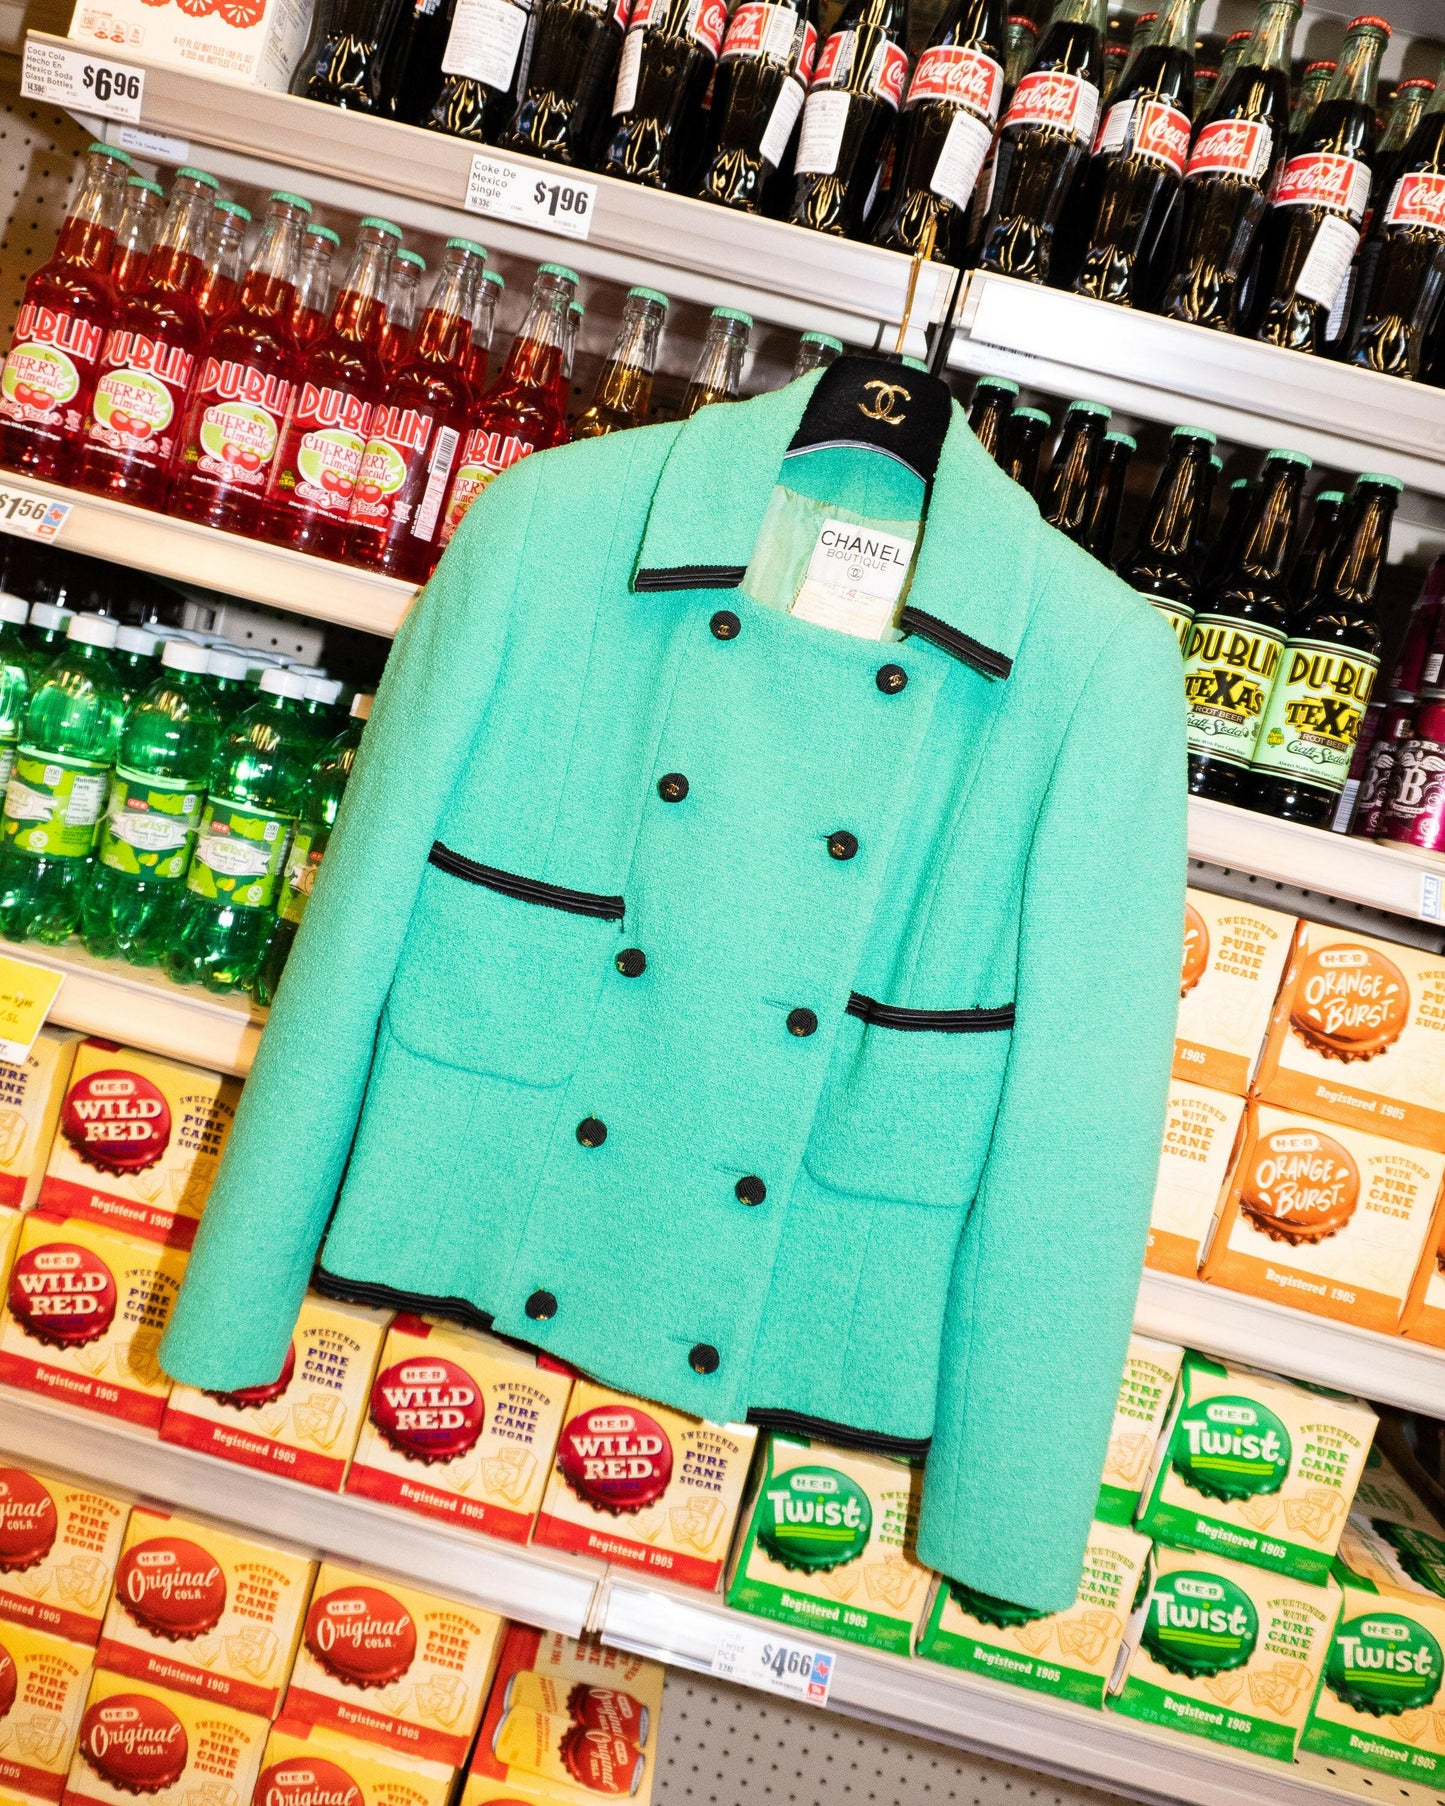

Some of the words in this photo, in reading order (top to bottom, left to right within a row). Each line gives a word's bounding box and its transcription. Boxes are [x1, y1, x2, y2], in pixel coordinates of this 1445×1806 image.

[27, 55, 50, 66] Hecho
[28, 47, 46, 56] Coca
[49, 51, 65, 61] Cola
[25, 72, 44, 82] Glass
[47, 78, 73, 89] Bottles
[26, 64, 52, 74] Mexico
[55, 70, 73, 80] Soda
[474, 161, 500, 174] Coke
[503, 169, 516, 178] De
[471, 183, 501, 197] Single
[472, 173, 507, 188] Mexico
[16, 368, 65, 391] Limeade
[99, 376, 157, 403] CHERRY
[110, 395, 161, 419] Limeade
[204, 408, 267, 437] CHERRY
[222, 425, 270, 451] Limeade
[821, 530, 905, 566] CHANEL
[826, 548, 887, 572] BOUTIQUE
[1186, 624, 1285, 679] DUBLIN
[1195, 704, 1218, 717] ROOT
[1218, 711, 1243, 724] BEER
[1287, 740, 1316, 760] Craft
[1302, 732, 1325, 746] ROOT
[1326, 738, 1347, 751] BEER
[1217, 916, 1278, 941] SWEETENED
[1233, 926, 1260, 940] WITH
[1220, 936, 1266, 956] PURE
[1218, 949, 1263, 970] CANE
[1214, 962, 1259, 981] SUGAR
[1305, 968, 1384, 1005] ORANGE
[1323, 997, 1395, 1034] BURST
[1181, 1048, 1207, 1065] 1905
[73, 1099, 163, 1120] WILD
[1316, 1084, 1376, 1112] Registered
[1380, 1102, 1406, 1119] 1905
[84, 1121, 152, 1142] RED
[183, 1114, 225, 1133] PURE
[180, 1126, 223, 1145] CANE
[177, 1138, 219, 1156] SUGAR
[1256, 1154, 1334, 1189] ORANGE
[1368, 1155, 1431, 1181] SWEETENED
[1385, 1166, 1413, 1181] WITH
[1372, 1176, 1419, 1196] PURE
[1273, 1182, 1345, 1217] BURST
[1369, 1189, 1414, 1209] CANE
[90, 1195, 146, 1223] Registered
[150, 1212, 174, 1229] 1905
[1365, 1201, 1411, 1221] SUGAR
[18, 1272, 108, 1294] WILD
[1265, 1268, 1326, 1297] Registered
[1330, 1286, 1357, 1304] 1905
[29, 1295, 98, 1316] RED
[36, 1369, 92, 1395] Registered
[94, 1384, 119, 1403] 1905
[492, 1382, 551, 1406] SWEETENED
[382, 1387, 475, 1408] WILD
[508, 1393, 533, 1406] WITH
[395, 1410, 464, 1431] RED
[496, 1402, 540, 1421] PURE
[494, 1414, 536, 1433] CANE
[490, 1426, 534, 1444] SUGAR
[1182, 1420, 1281, 1462] Twist
[1299, 1423, 1361, 1449] SWEETENED
[1316, 1434, 1343, 1448] WITH
[570, 1435, 664, 1458] WILD
[1304, 1443, 1349, 1464] PURE
[583, 1458, 653, 1480] RED
[1301, 1456, 1345, 1478] CANE
[1297, 1469, 1342, 1488] SUGAR
[400, 1483, 458, 1512] Registered
[460, 1501, 485, 1519] 1905
[766, 1490, 861, 1528] Twist
[1195, 1520, 1257, 1550] Registered
[1261, 1539, 1287, 1558] 1905
[588, 1534, 646, 1562] Registered
[649, 1551, 674, 1569] 1905
[127, 1567, 220, 1603] Original
[233, 1563, 291, 1586] SWEETENED
[249, 1573, 274, 1586] WITH
[174, 1589, 201, 1600] COLA
[238, 1582, 280, 1600] PURE
[236, 1593, 277, 1613] CANE
[781, 1593, 840, 1621] Registered
[843, 1611, 868, 1628] 1905
[1151, 1592, 1248, 1635] Twist
[232, 1605, 274, 1623] SUGAR
[316, 1615, 410, 1651] Original
[365, 1638, 392, 1649] COLA
[1337, 1636, 1433, 1675] Twist
[148, 1659, 203, 1686] Registered
[206, 1677, 230, 1694] 1905
[337, 1707, 393, 1732] Registered
[397, 1725, 420, 1740] 1905
[1163, 1696, 1224, 1725] Registered
[1226, 1715, 1252, 1733] 1905
[91, 1722, 181, 1757] Original
[137, 1744, 163, 1755] COLA
[586, 1729, 619, 1792] Original
[1349, 1734, 1408, 1762] Registered
[1412, 1753, 1437, 1770] 1905
